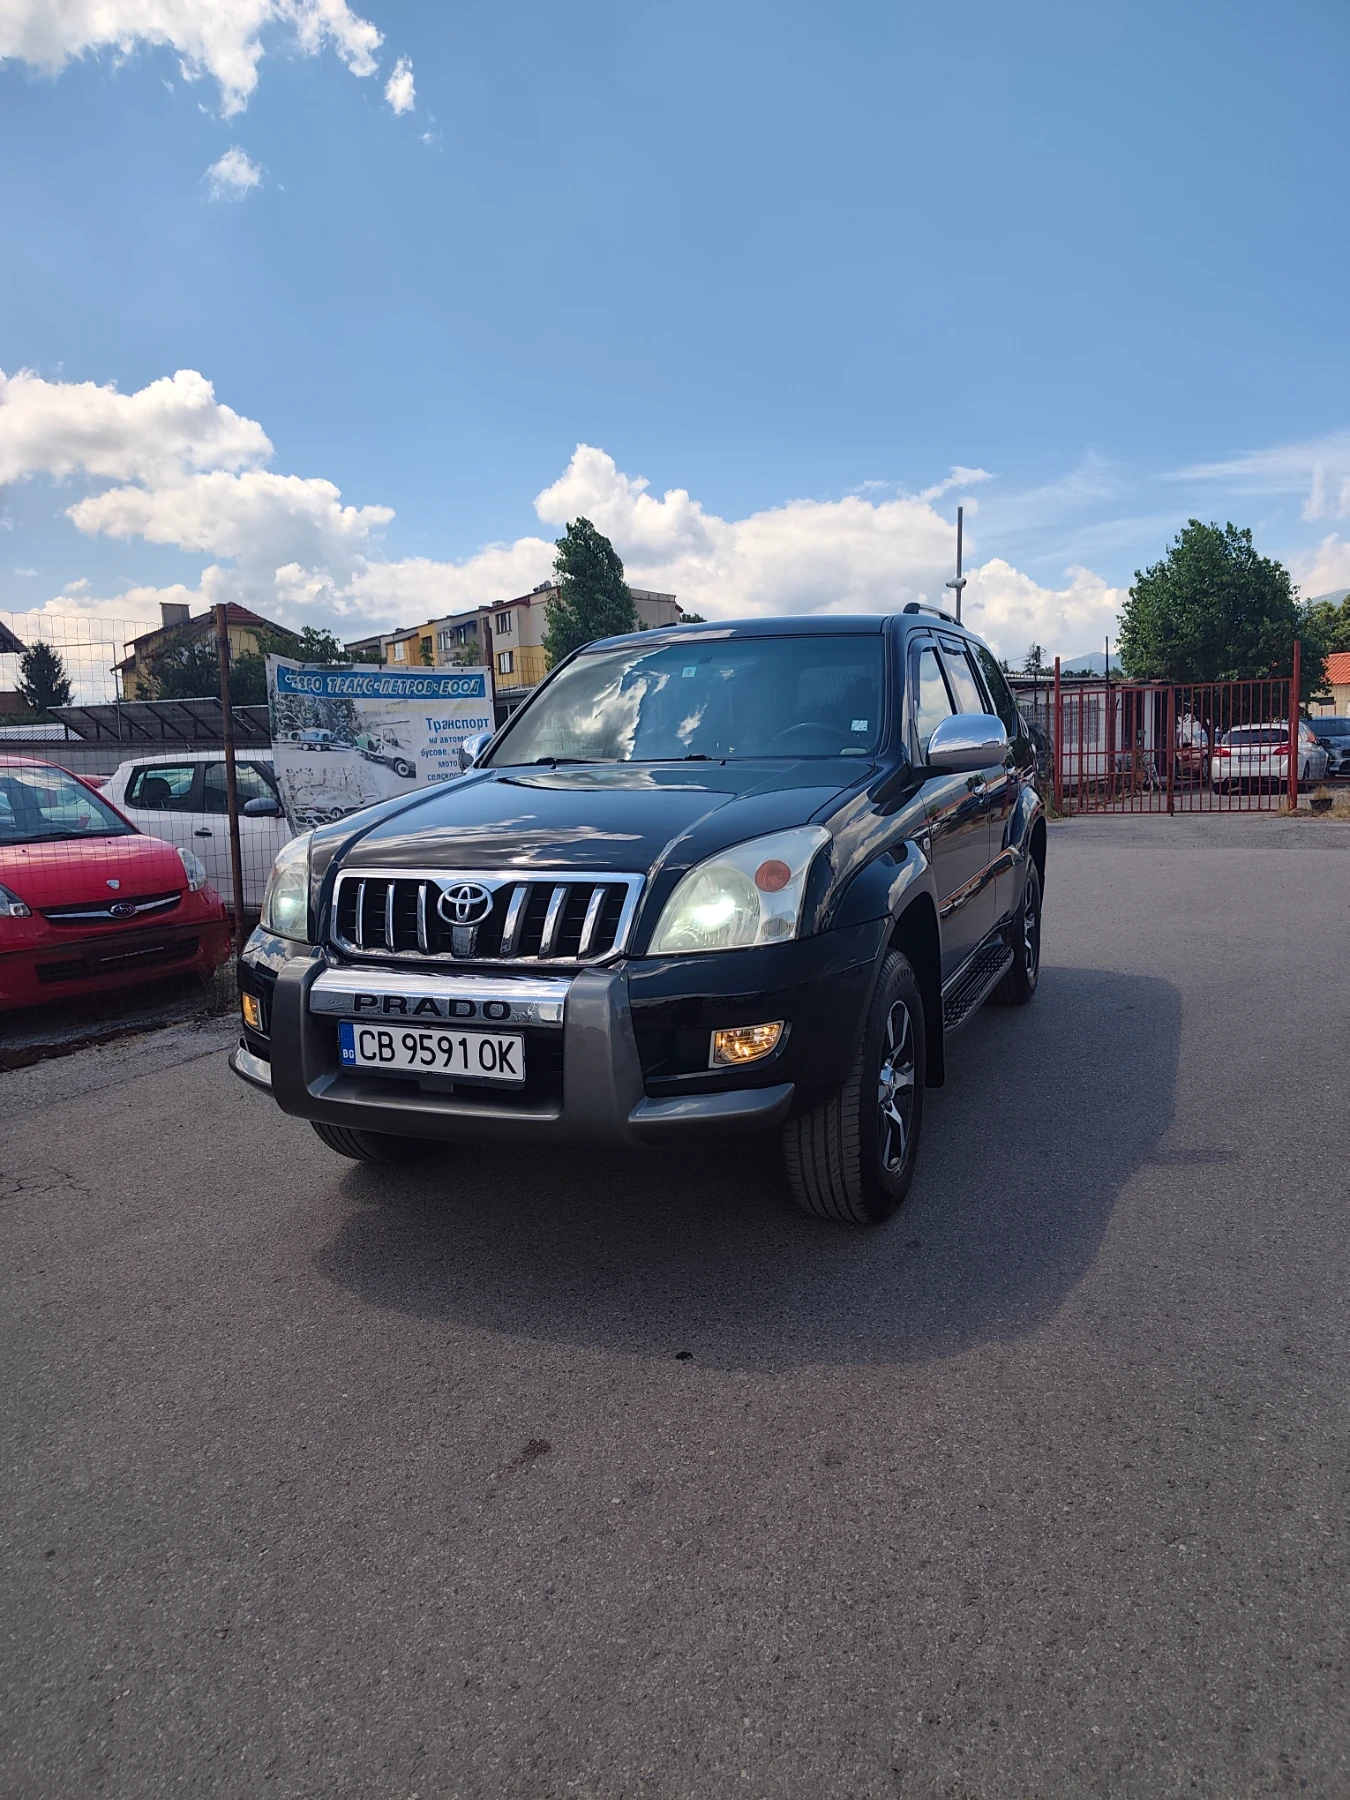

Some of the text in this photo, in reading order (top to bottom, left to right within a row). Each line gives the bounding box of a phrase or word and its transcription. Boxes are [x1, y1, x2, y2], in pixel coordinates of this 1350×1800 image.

[425, 717, 490, 733] Транспорт
[420, 748, 450, 759] бусове,
[353, 994, 512, 1021] PRADO
[342, 1048, 355, 1059] BG
[359, 1029, 396, 1063] CB
[401, 1033, 469, 1070] 9591
